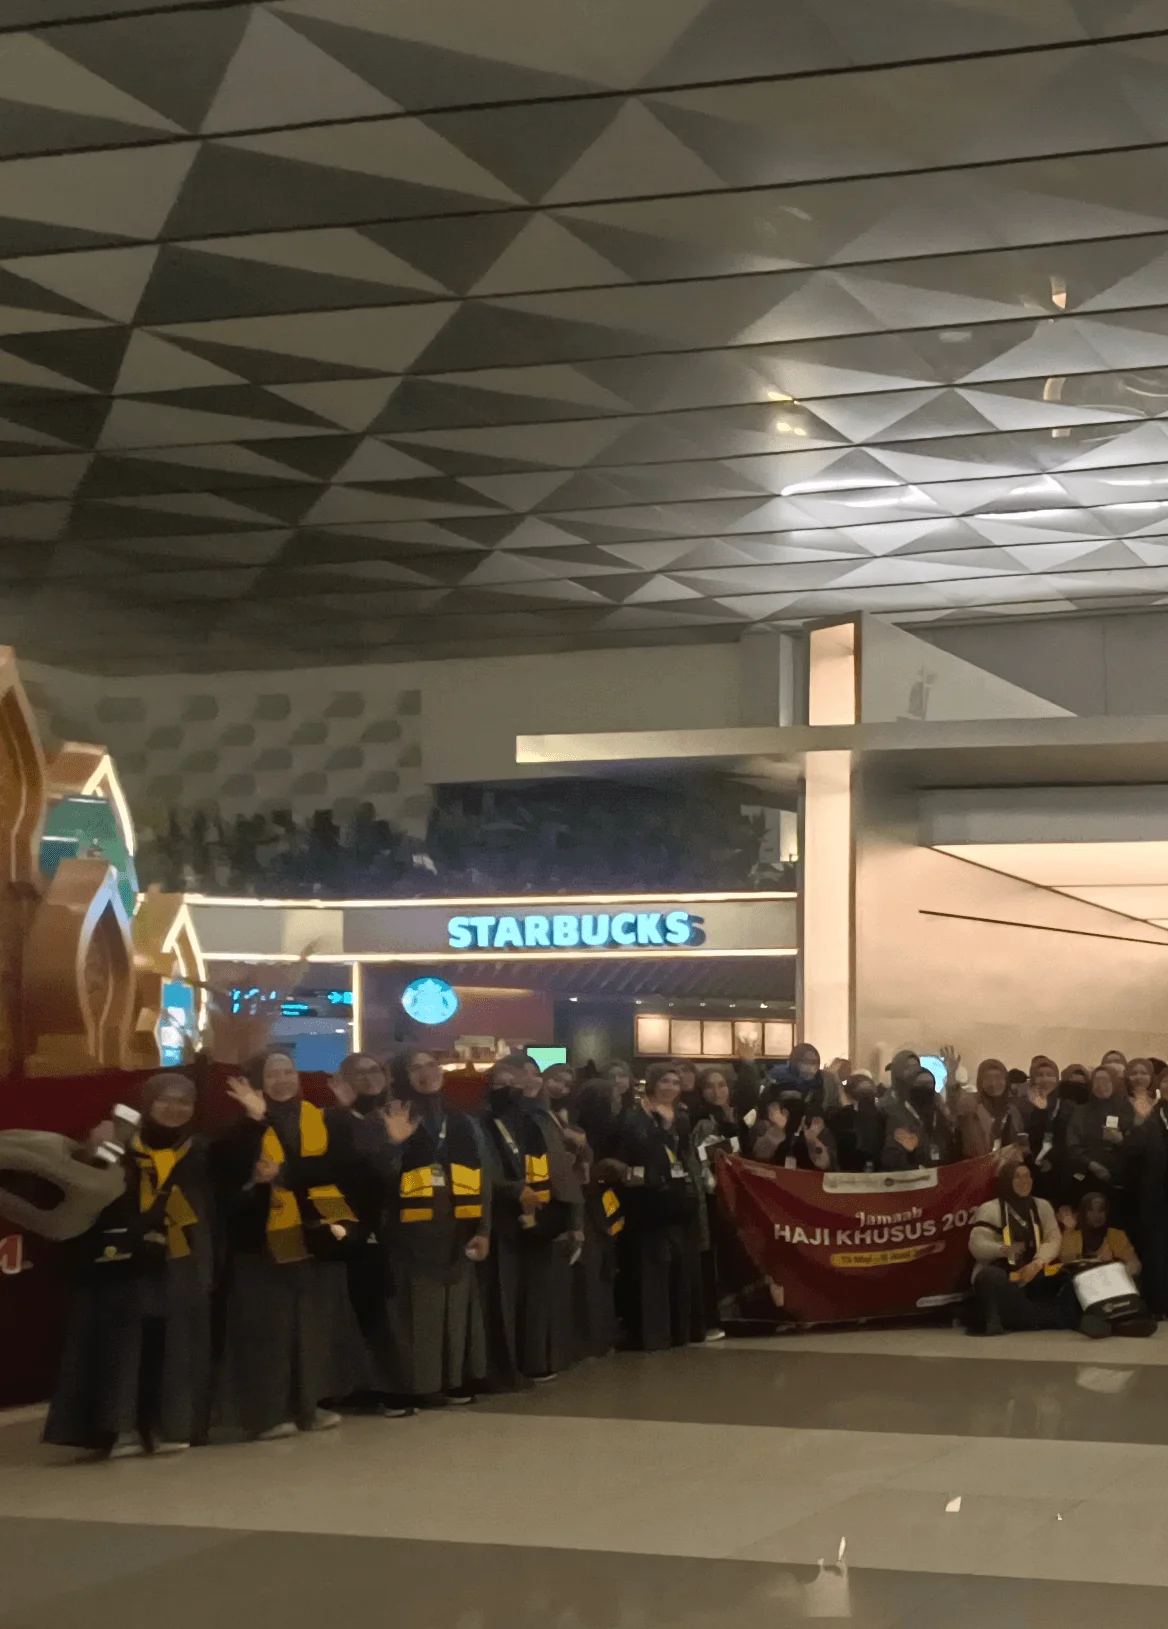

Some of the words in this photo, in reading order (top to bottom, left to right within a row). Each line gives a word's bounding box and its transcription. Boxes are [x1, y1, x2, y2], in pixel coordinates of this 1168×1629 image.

[447, 911, 693, 949] STARBUCKS
[774, 1223, 830, 1246] HAJI
[836, 1219, 937, 1246] KHUSUS
[941, 1206, 980, 1232] 202
